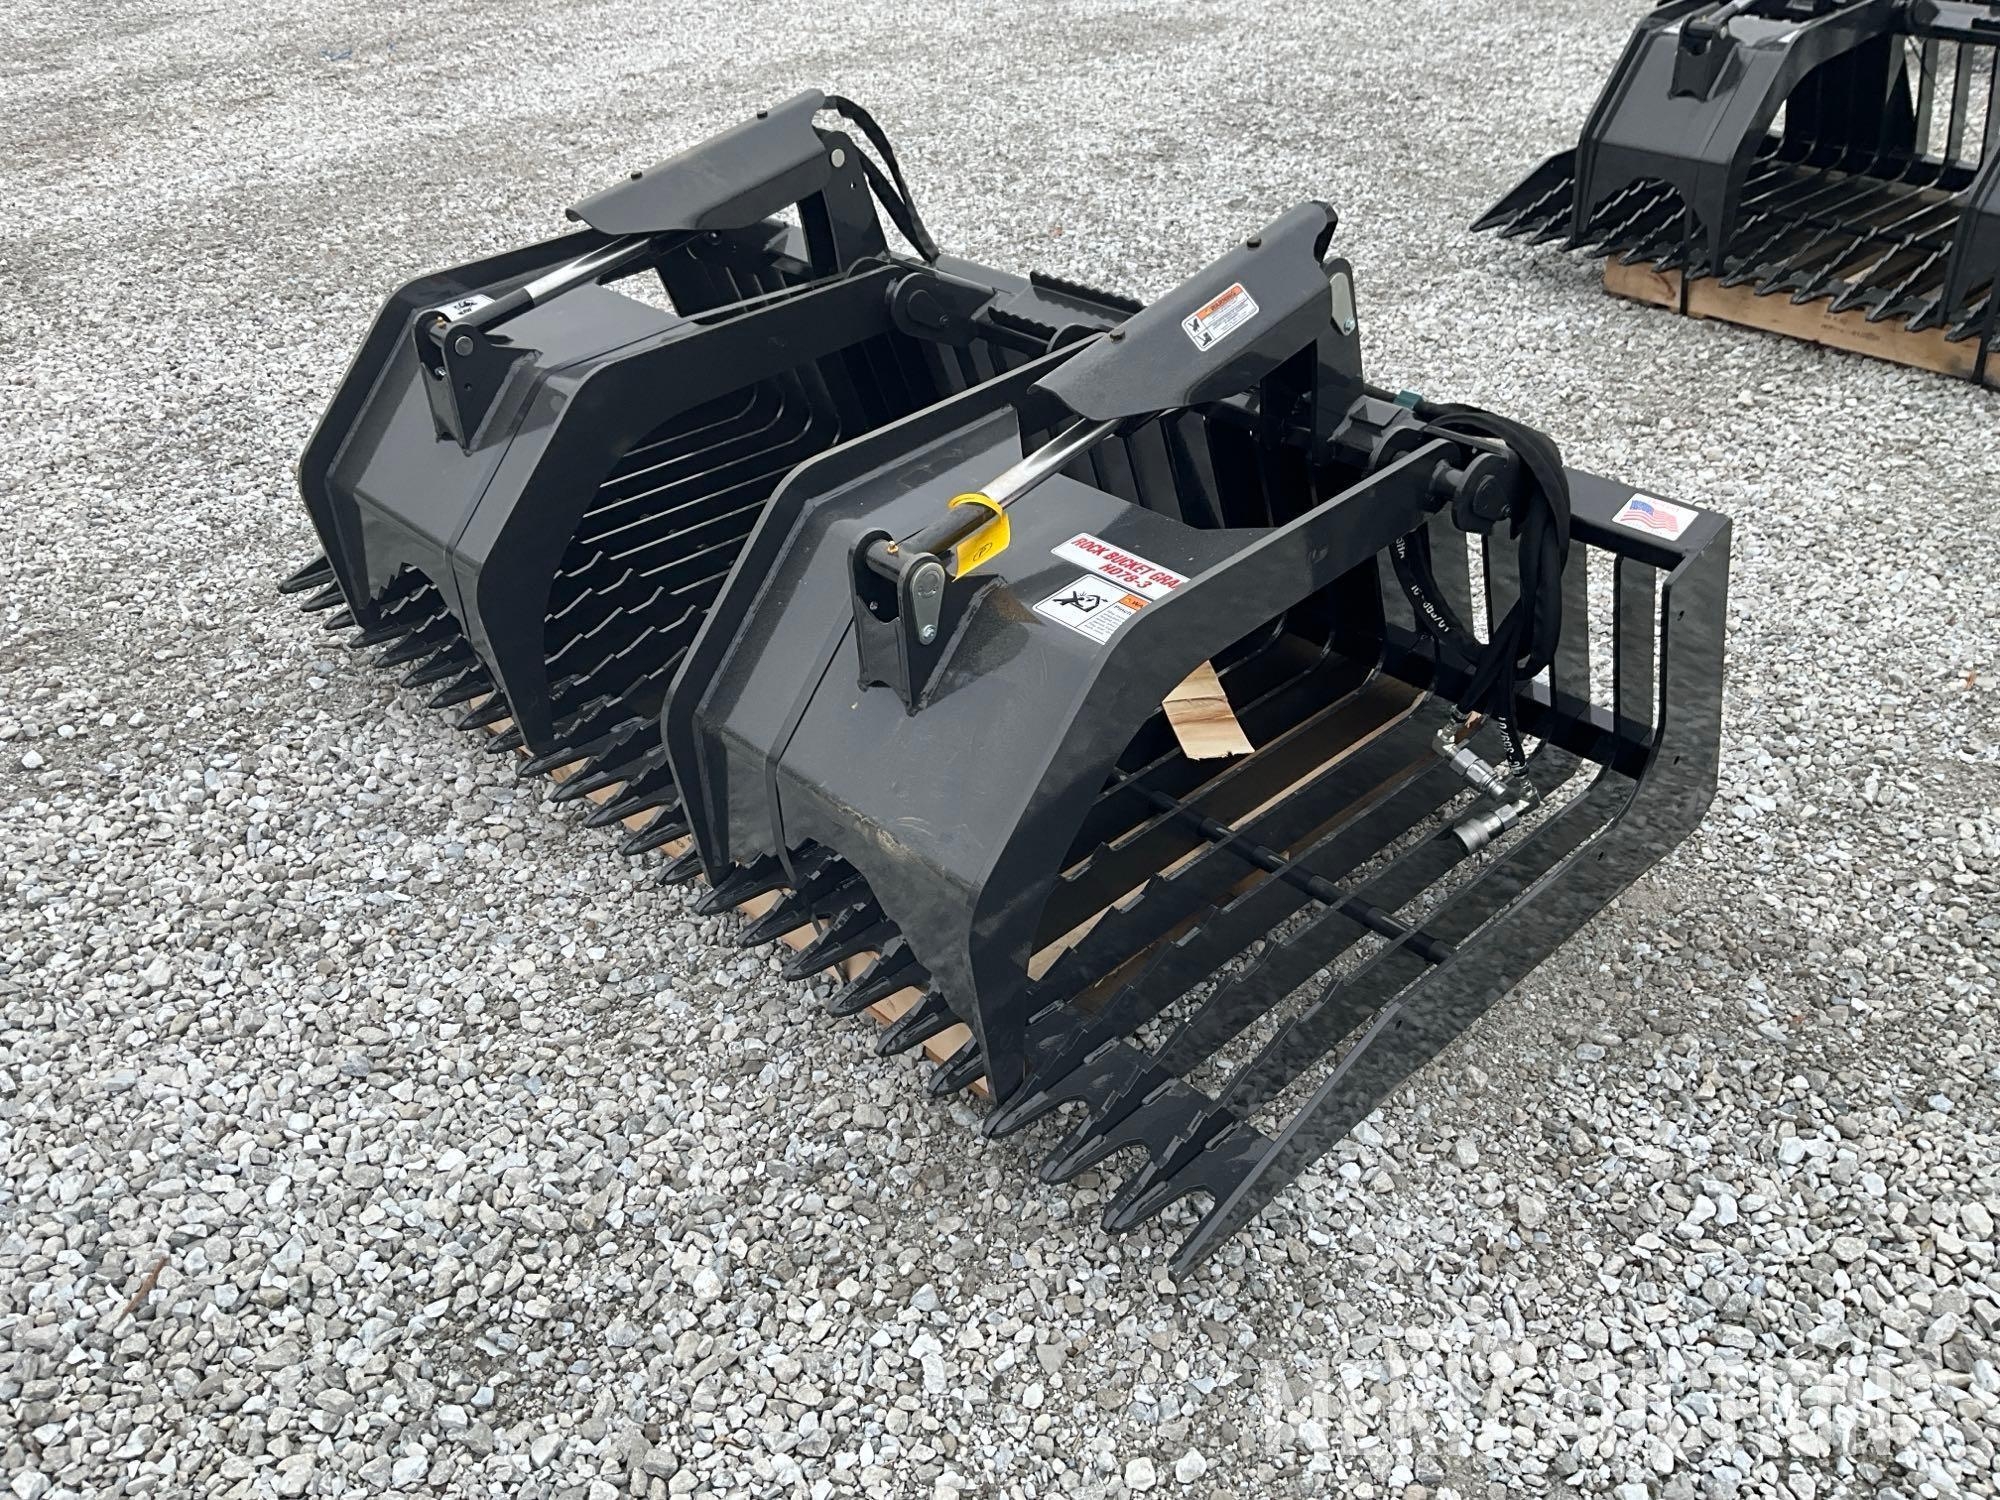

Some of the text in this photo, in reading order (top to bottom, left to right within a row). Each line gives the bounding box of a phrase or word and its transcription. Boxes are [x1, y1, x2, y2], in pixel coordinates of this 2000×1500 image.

[1071, 537, 1107, 557] ROCK
[1106, 553, 1156, 576] BUCKET
[1099, 564, 1152, 588] HD78-3
